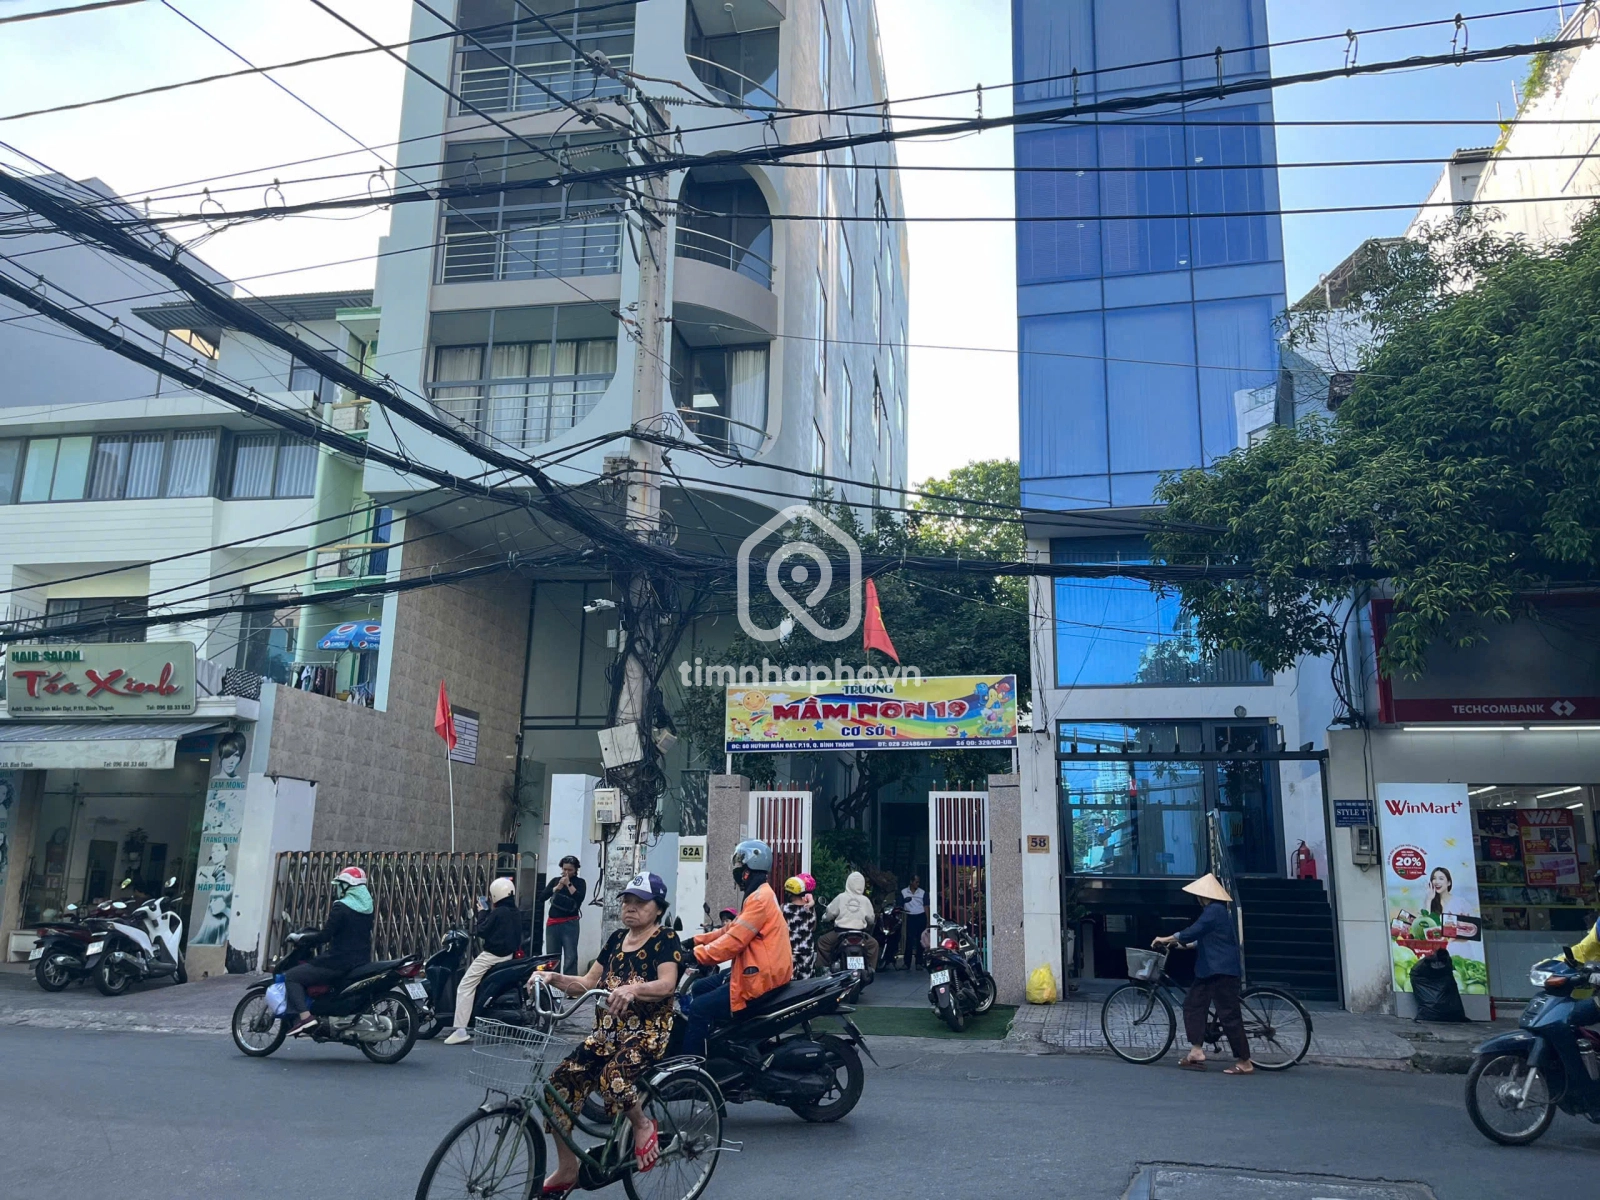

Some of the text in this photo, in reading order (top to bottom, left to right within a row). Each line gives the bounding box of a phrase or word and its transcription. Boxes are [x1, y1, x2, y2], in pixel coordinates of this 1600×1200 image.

[12, 650, 82, 662] HAIR SALON
[13, 662, 183, 697] Tóc Xinh
[773, 696, 968, 720] MẦM NON 19
[1452, 704, 1545, 714] TECHCOMBANK
[842, 724, 897, 737] CƠ SỞ 1
[1336, 808, 1360, 816] STYLE
[1031, 837, 1046, 848] 58
[683, 847, 700, 856] 62A
[1395, 857, 1422, 867] 20%
